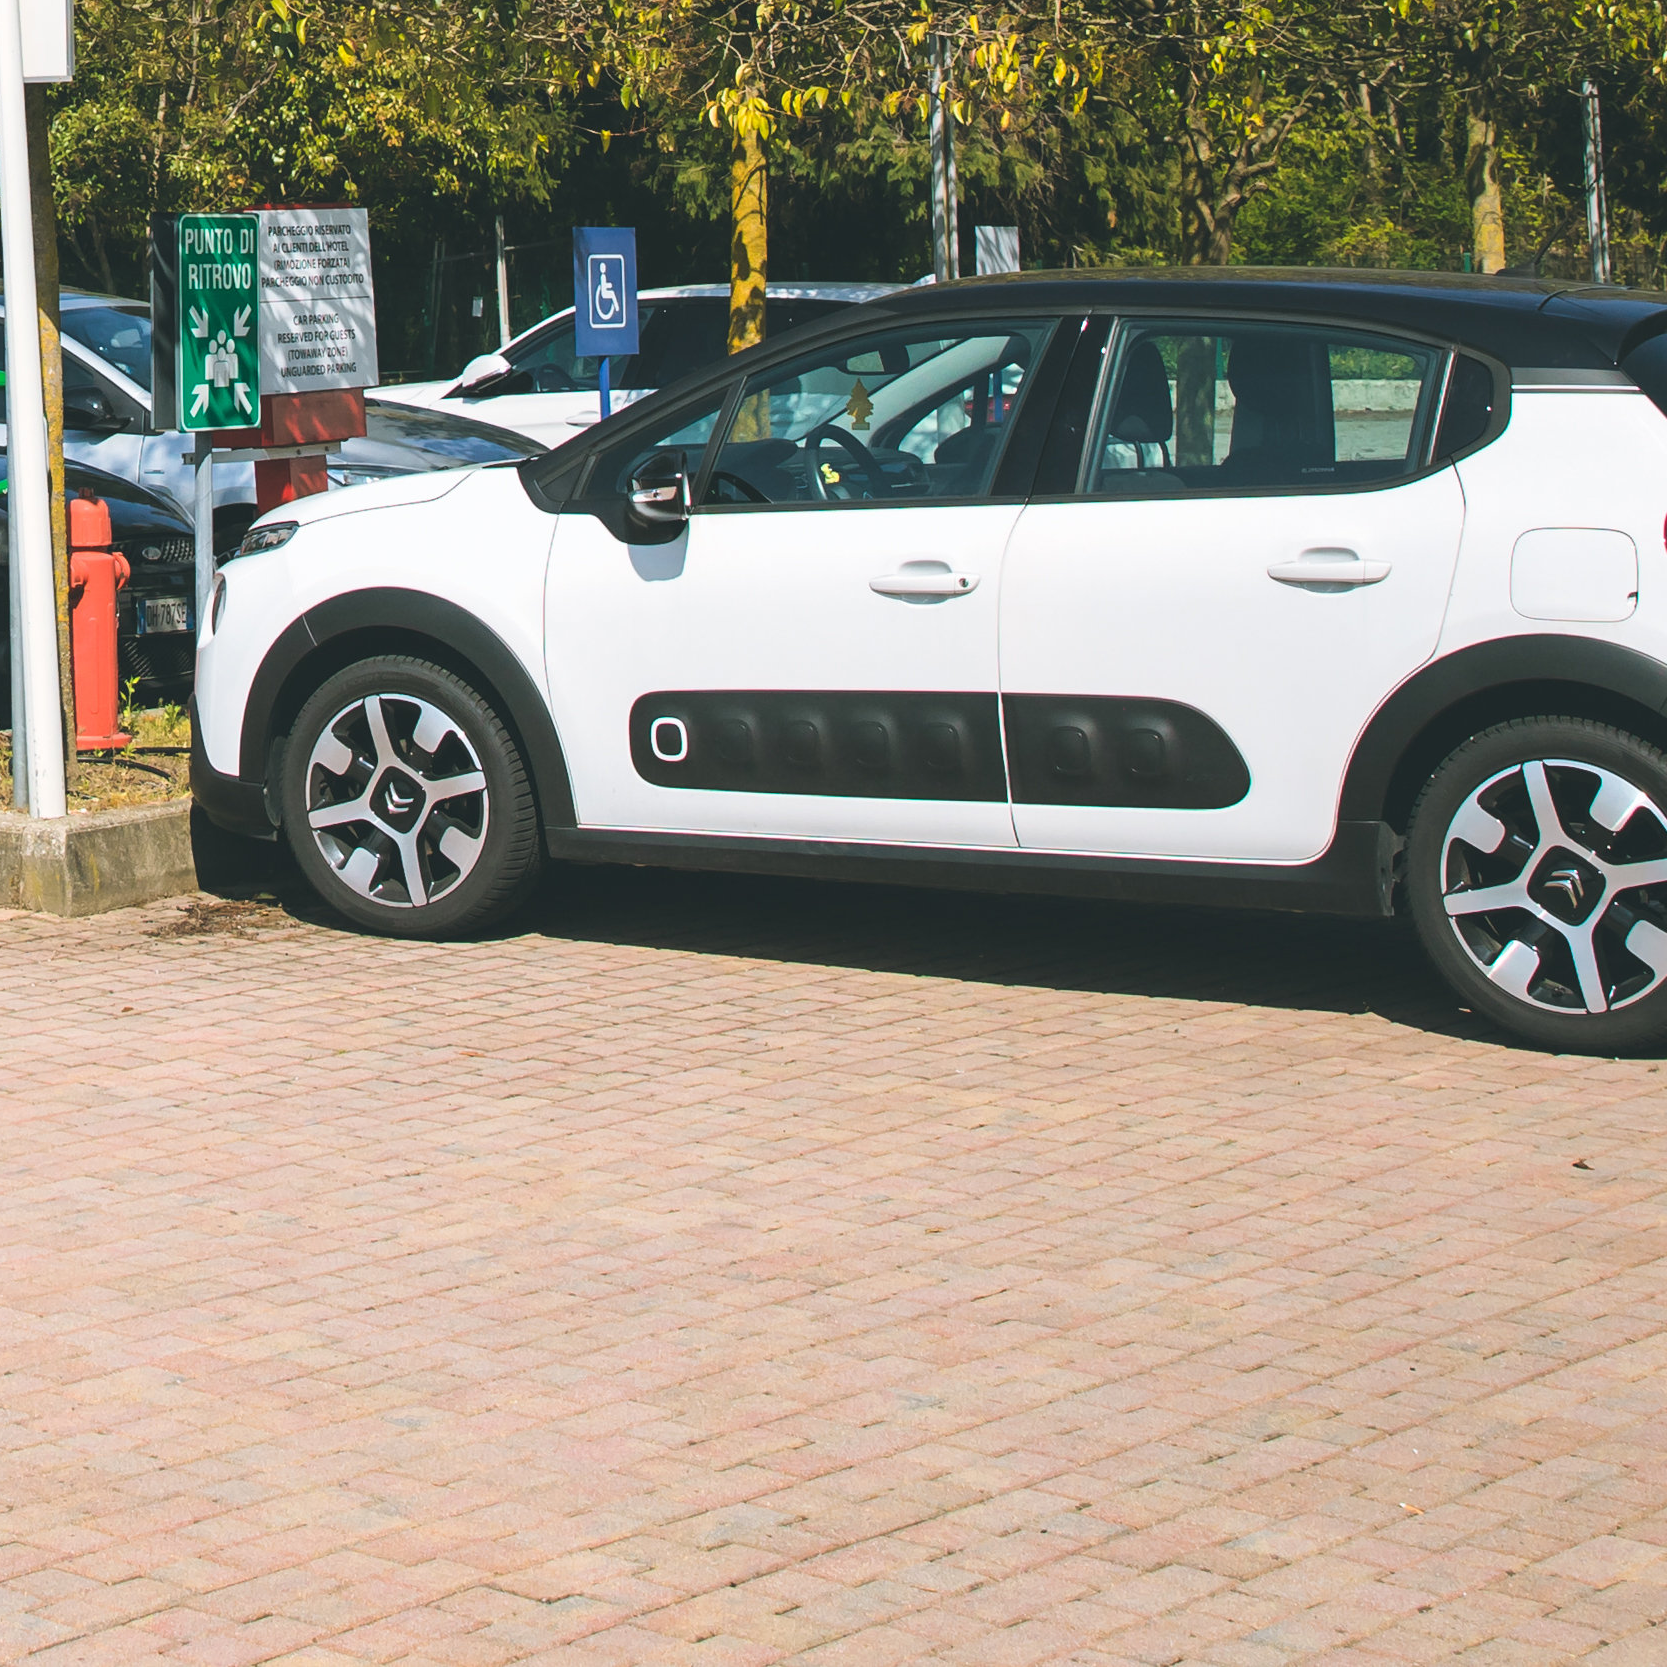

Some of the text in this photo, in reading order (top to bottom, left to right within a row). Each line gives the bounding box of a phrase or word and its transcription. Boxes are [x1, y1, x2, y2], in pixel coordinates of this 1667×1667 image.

[268, 224, 351, 236] PARCHEGGIO RISERVATO
[185, 228, 254, 254] PUNTO DI
[273, 241, 349, 253] AI CLIENTI DELL'HOTEL
[188, 263, 251, 289] RITROVO
[261, 276, 307, 288] PARCHEGGIO
[308, 275, 324, 286] NON
[293, 313, 339, 326] CAR PARKING
[277, 329, 356, 344] RESERVED FOR GUESTS
[281, 362, 356, 377] UNGUARDED PARKING
